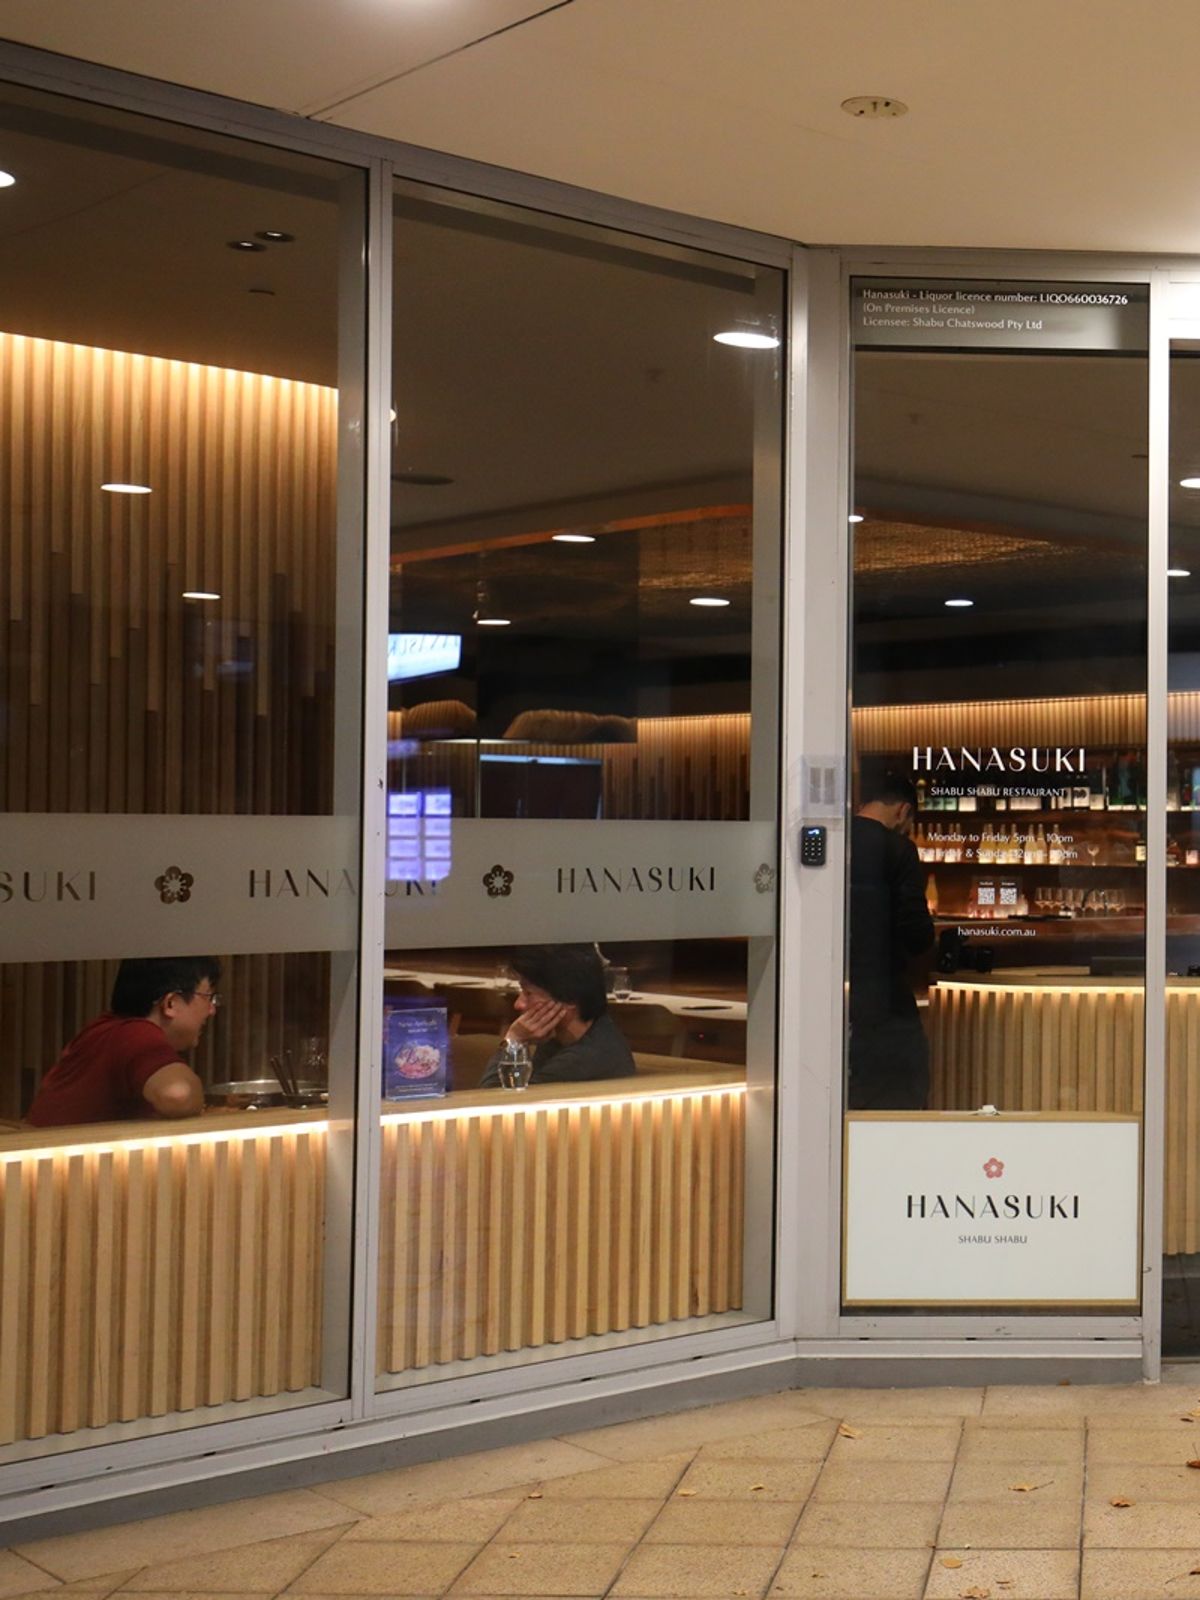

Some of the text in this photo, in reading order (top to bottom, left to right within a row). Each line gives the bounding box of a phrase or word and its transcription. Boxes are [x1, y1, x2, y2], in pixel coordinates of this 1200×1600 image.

[863, 289, 910, 299] Hanasuki
[919, 290, 953, 301] Liquor
[956, 291, 991, 301] licence
[994, 293, 1037, 302] number:
[863, 303, 975, 314] (On Premises Licence)
[863, 317, 1042, 330] Licensee: Shabu Chatswood Pty Ltd
[912, 747, 1085, 772] HANASUKI
[931, 787, 1065, 797] SHABU SHABU RESTAURANT
[928, 832, 966, 842] Monday
[968, 833, 979, 842] to
[982, 832, 1009, 843] Friday
[1014, 832, 1034, 843] 5pm
[1047, 833, 1073, 843] 10pm
[965, 849, 974, 858] &
[557, 866, 715, 893] HANASUKI
[958, 926, 1036, 937] hanasuki.com.au
[906, 1194, 1079, 1219] HANASUKI
[958, 1235, 1028, 1244] SHABU SHABU
